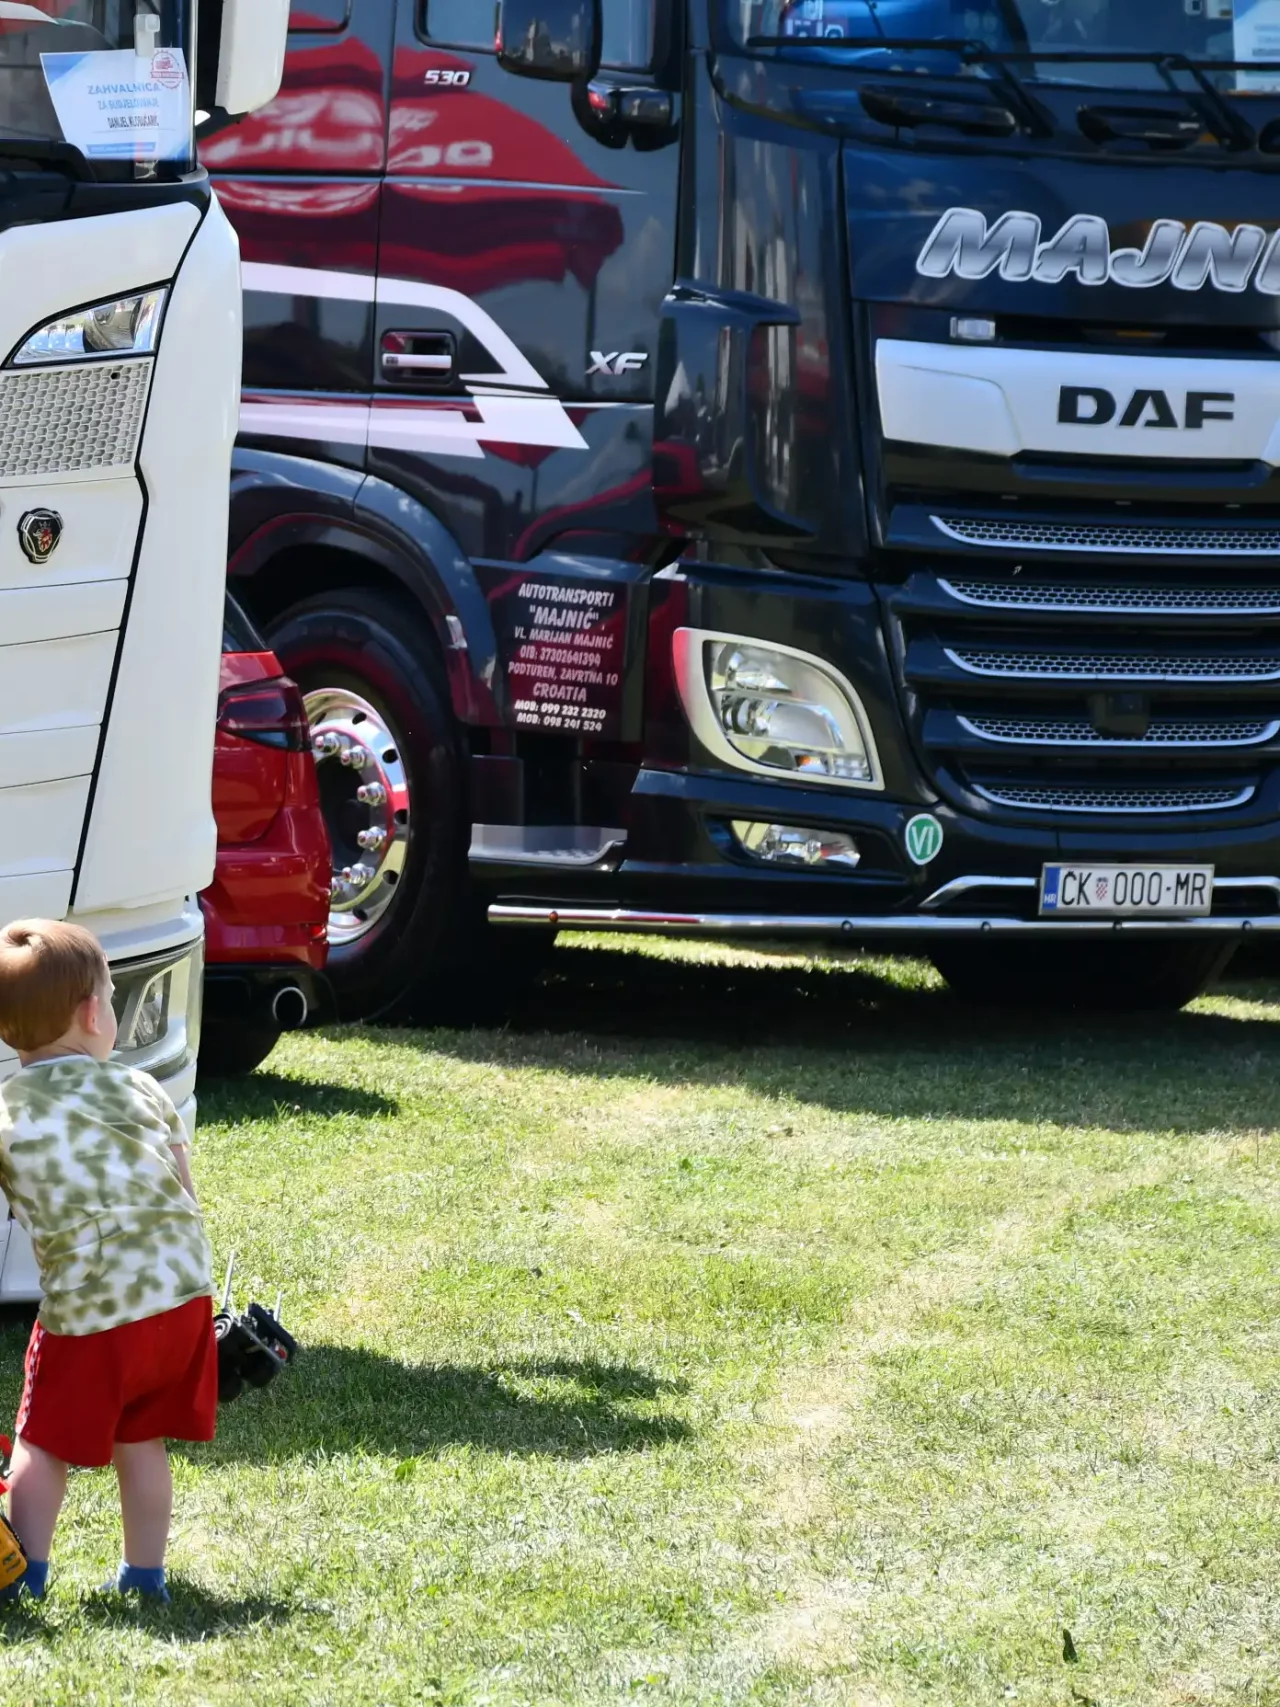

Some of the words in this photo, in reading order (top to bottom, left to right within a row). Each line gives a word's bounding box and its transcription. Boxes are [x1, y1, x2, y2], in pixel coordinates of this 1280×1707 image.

[424, 70, 470, 86] 530
[87, 82, 161, 95] ZAHVALNICA
[586, 350, 649, 376] XF
[1057, 385, 1235, 429] DAF
[518, 583, 615, 607] AUTOTRANSPORTI
[529, 630, 572, 645] MARIJAN
[573, 633, 614, 649] MAJNIĆ
[560, 668, 603, 685] ZAVRTNA
[606, 672, 619, 686] 10
[533, 683, 587, 702] CROATIA
[514, 699, 539, 712] MOB:
[540, 701, 560, 714] 099
[561, 704, 579, 716] 232
[582, 707, 607, 720] 2320
[517, 712, 541, 725] MOB:
[543, 714, 562, 727] 098
[564, 717, 580, 730] 241
[583, 720, 603, 732] 524
[911, 826, 935, 857] VI
[1044, 893, 1056, 905] HR
